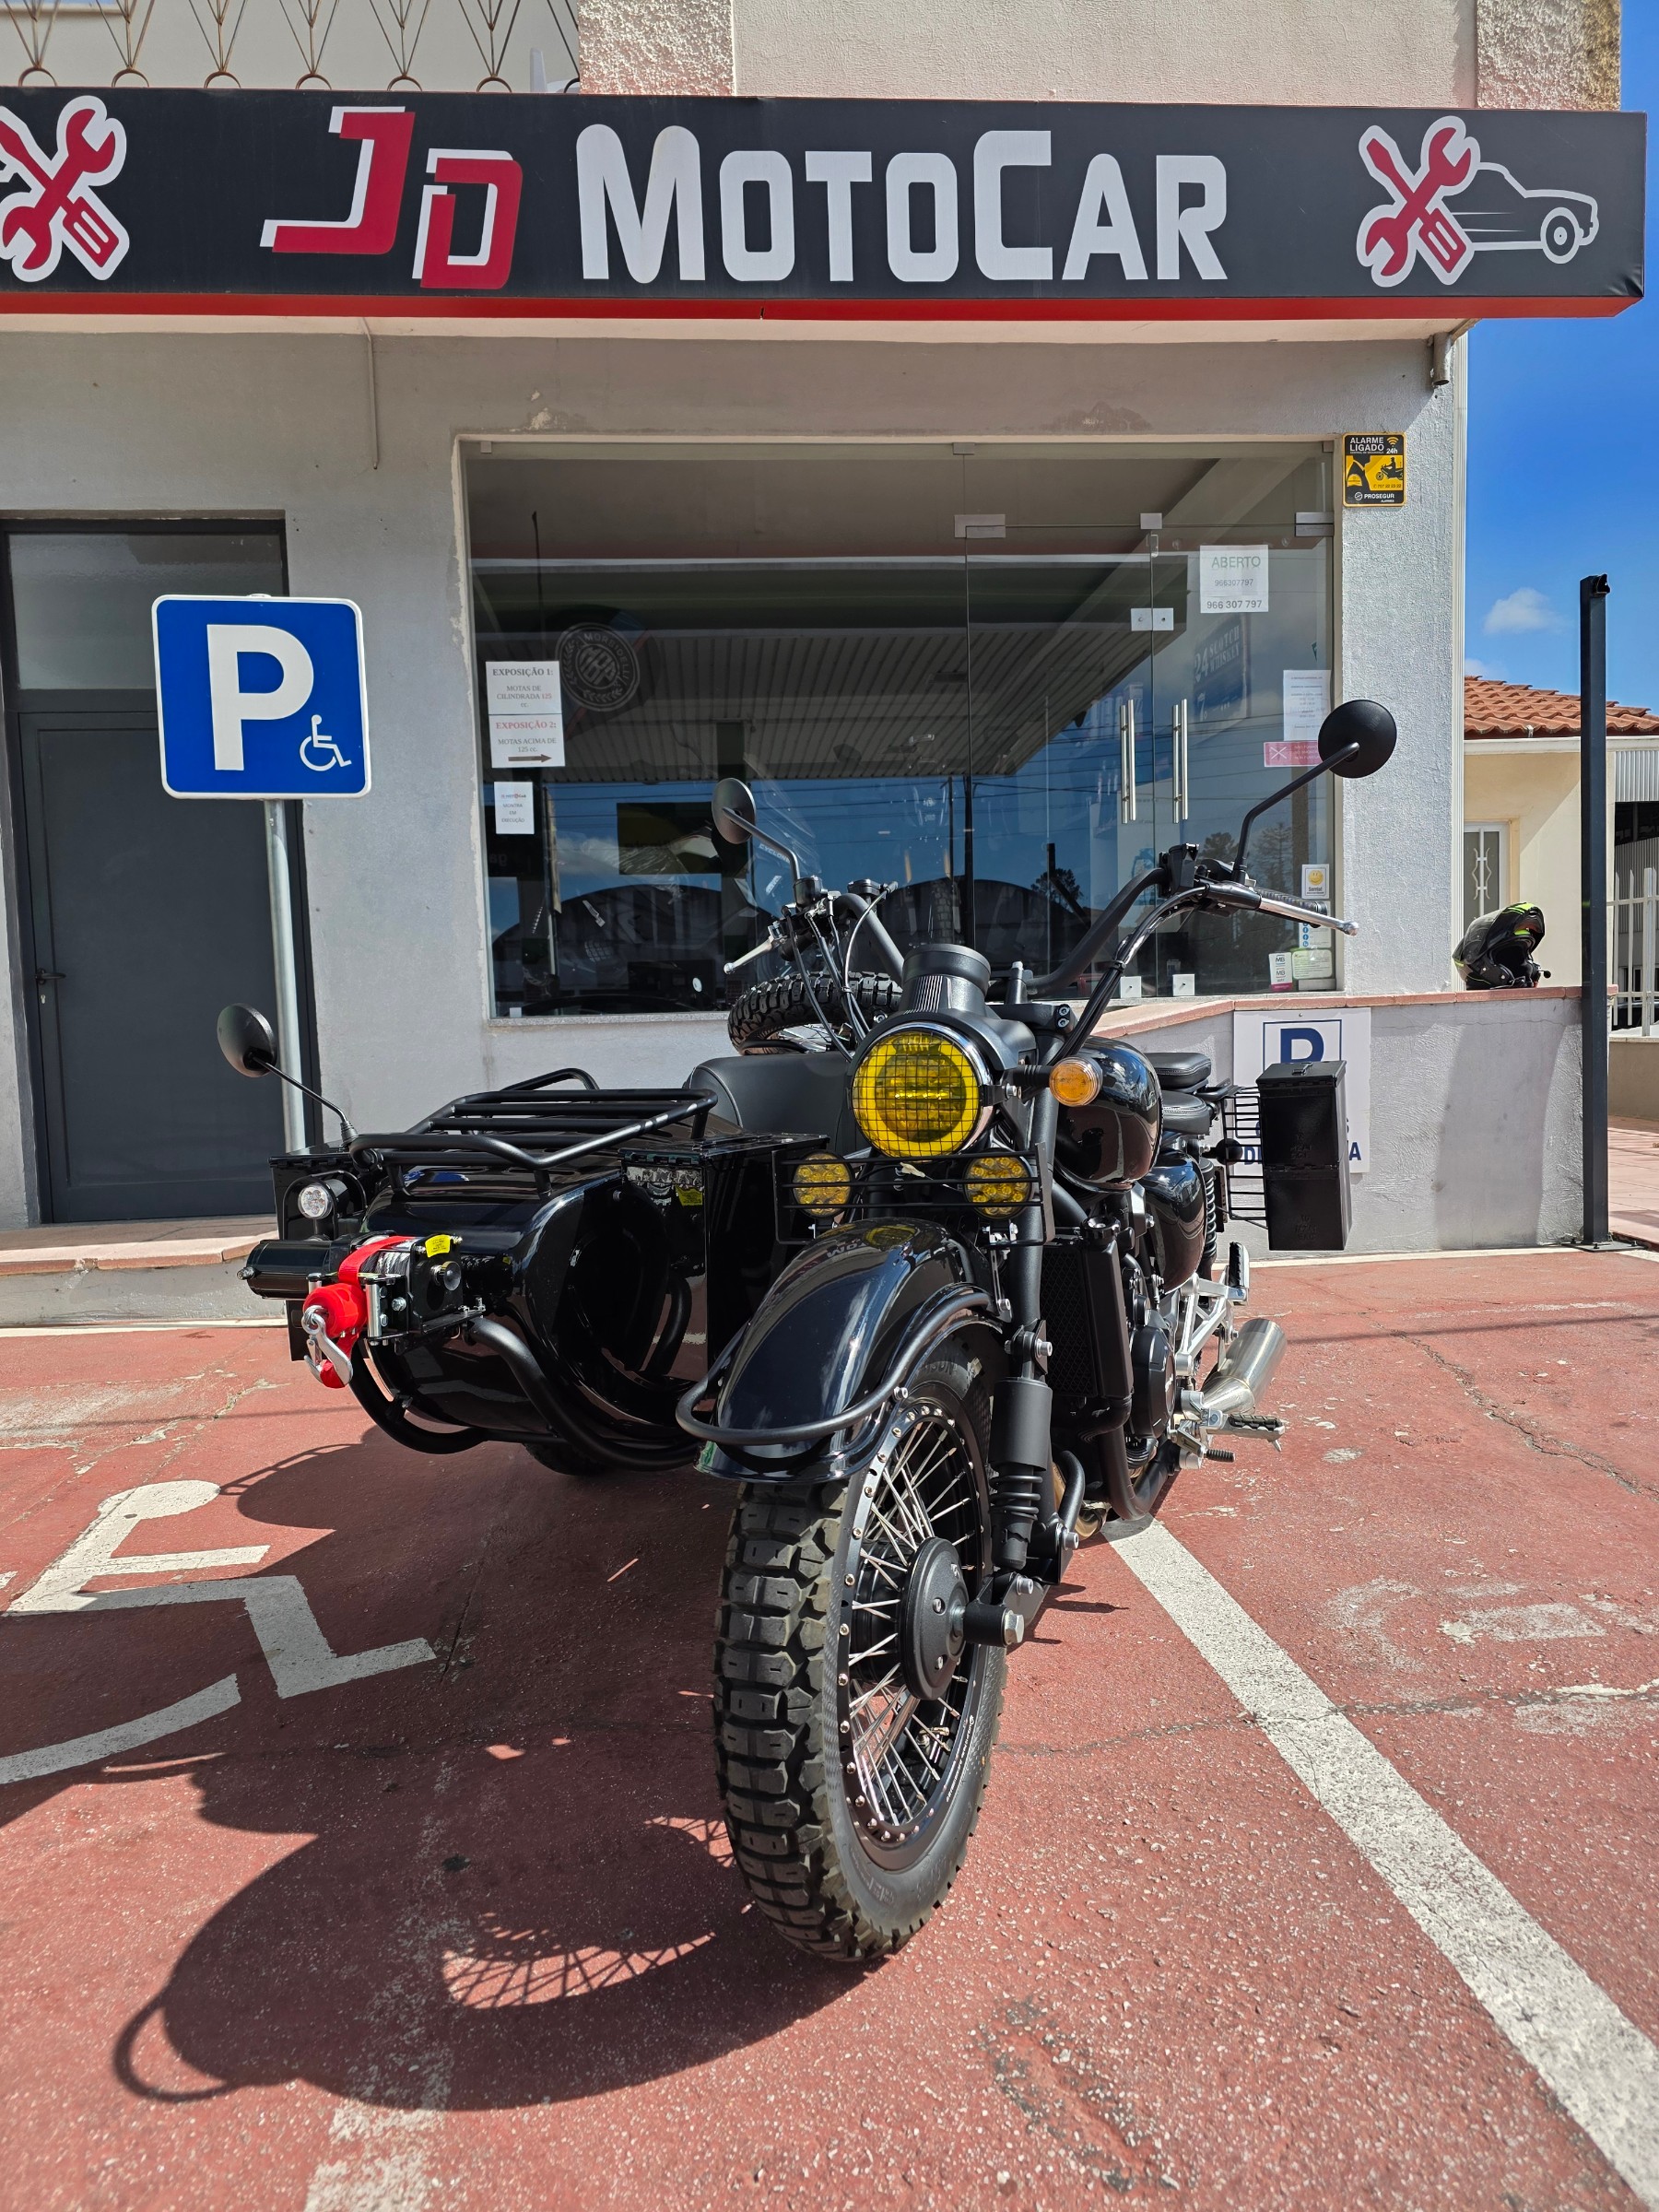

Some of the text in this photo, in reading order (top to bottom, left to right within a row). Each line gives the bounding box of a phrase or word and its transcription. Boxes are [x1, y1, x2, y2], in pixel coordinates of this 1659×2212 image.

[260, 105, 523, 289] JD
[1211, 556, 1261, 569] ABERTO
[1214, 578, 1253, 587] 966307797
[1206, 599, 1263, 609] 966 307 797
[1209, 625, 1240, 658] SCOTCH
[492, 667, 545, 677] EXPOSIÇÃO
[207, 624, 314, 771] P
[496, 720, 547, 730] EXPOSIÇÃO
